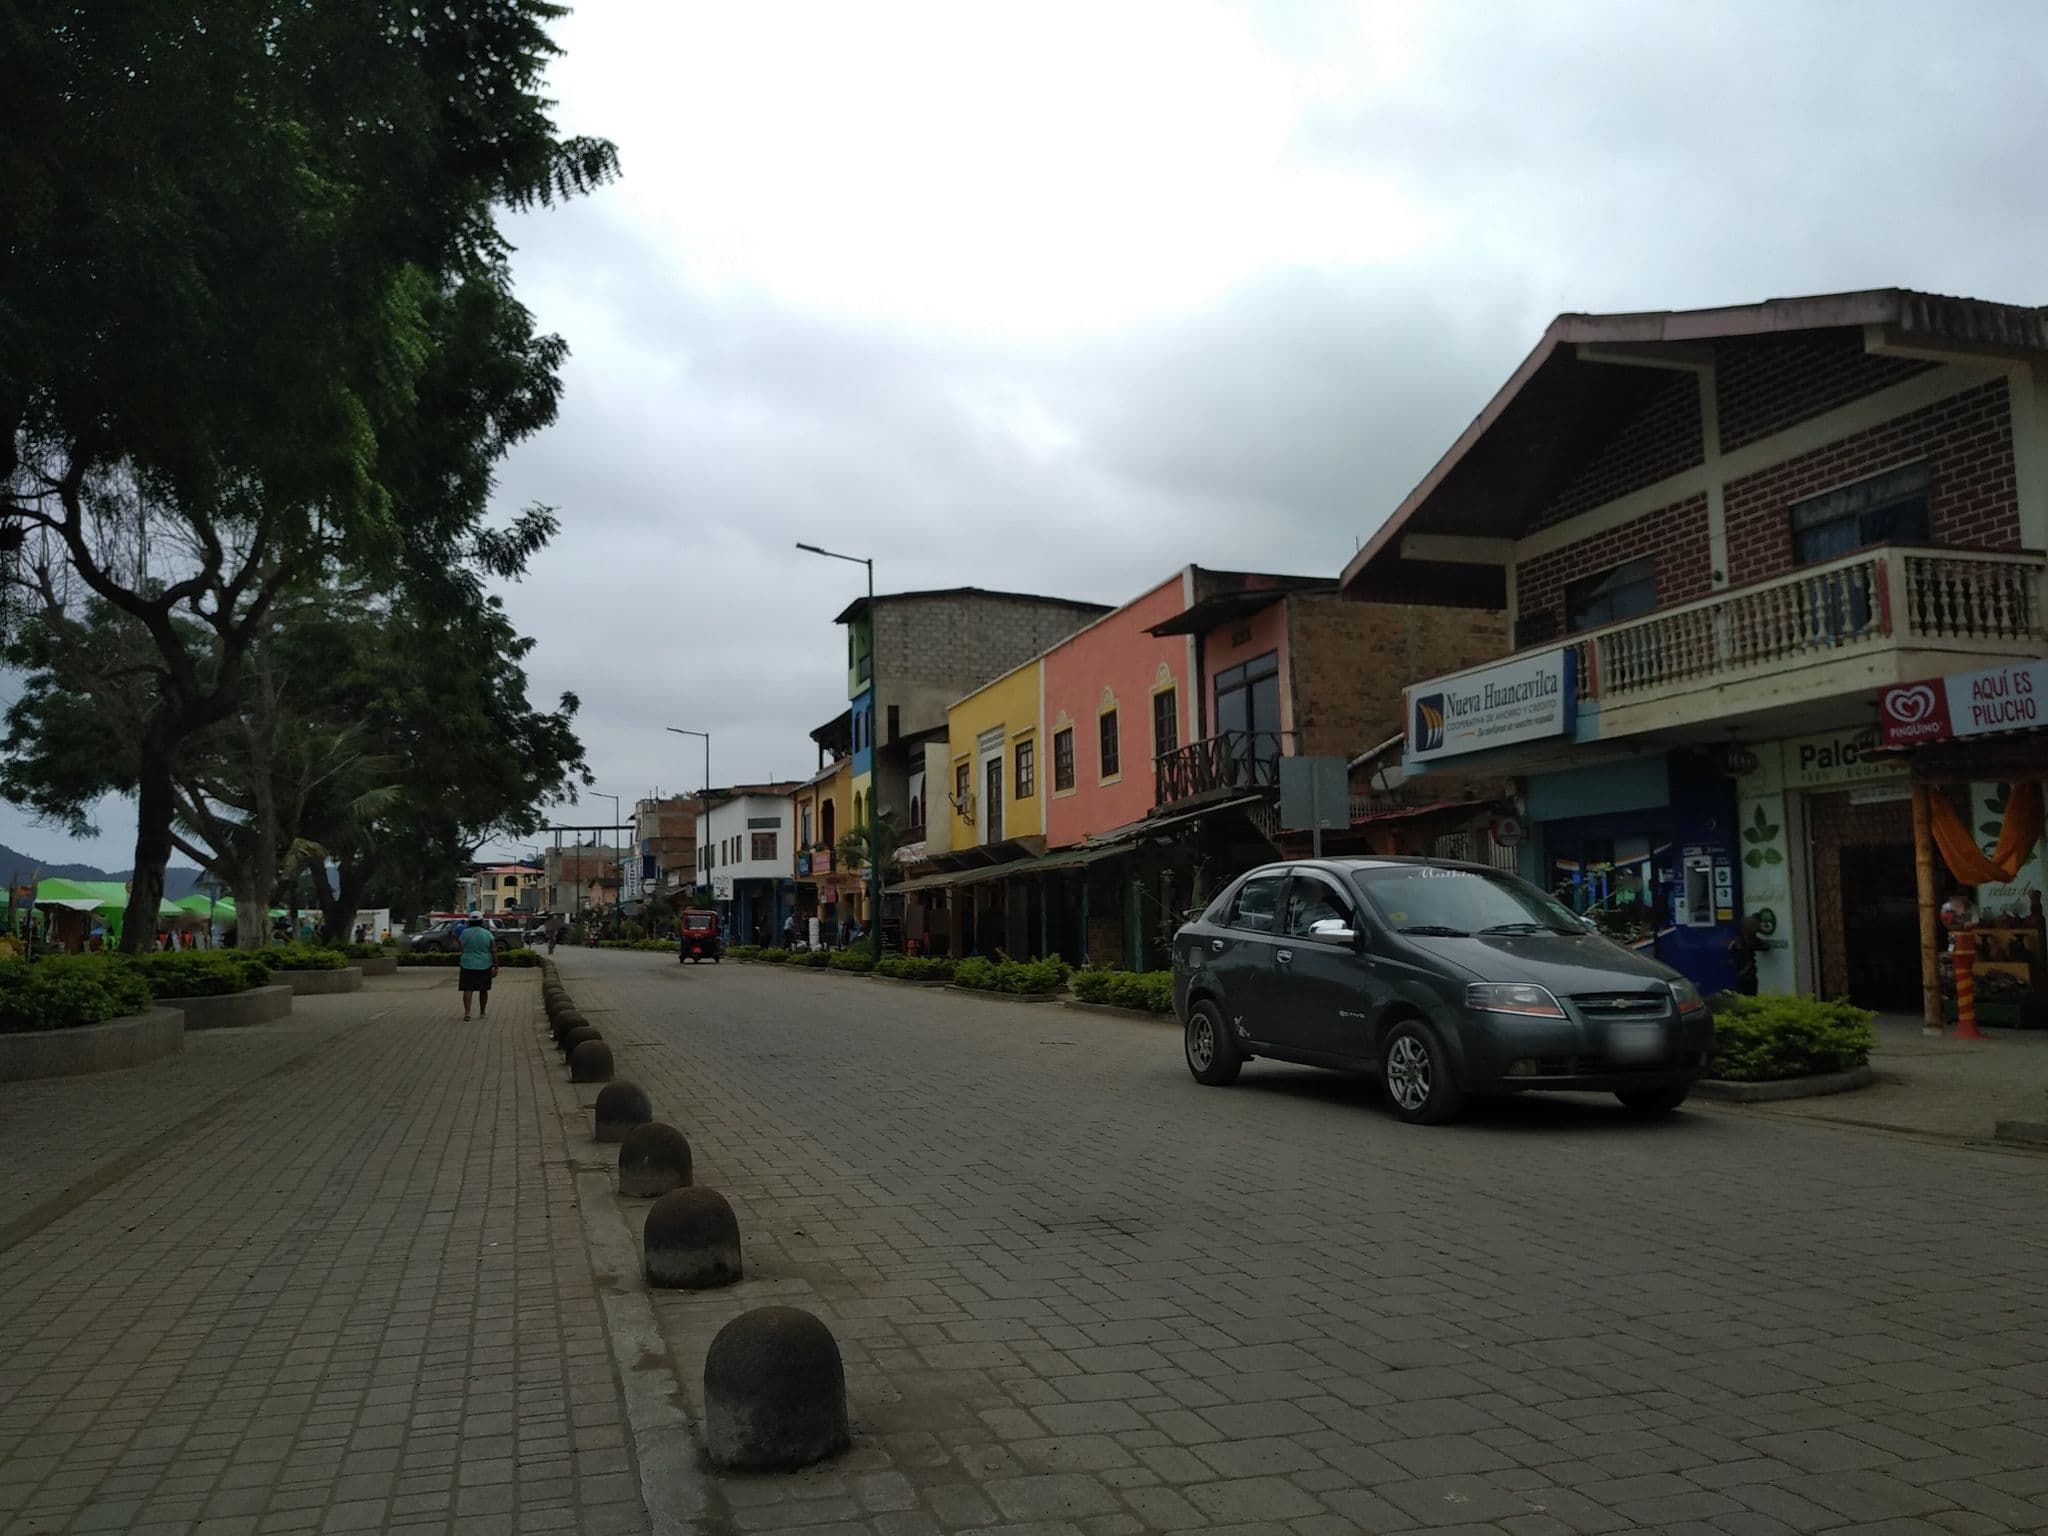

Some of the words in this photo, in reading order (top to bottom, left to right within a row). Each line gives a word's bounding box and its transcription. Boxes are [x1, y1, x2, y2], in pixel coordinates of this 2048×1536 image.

[1447, 692, 1480, 719] Nueva
[1484, 669, 1558, 710] Huancavilca
[1973, 668, 2010, 700] AQUÍ
[2014, 671, 2032, 695] ES
[1446, 716, 1484, 732] COOPERATIVA
[1973, 697, 2036, 726] PILUCHO
[1890, 721, 1940, 738] PINGÜINO
